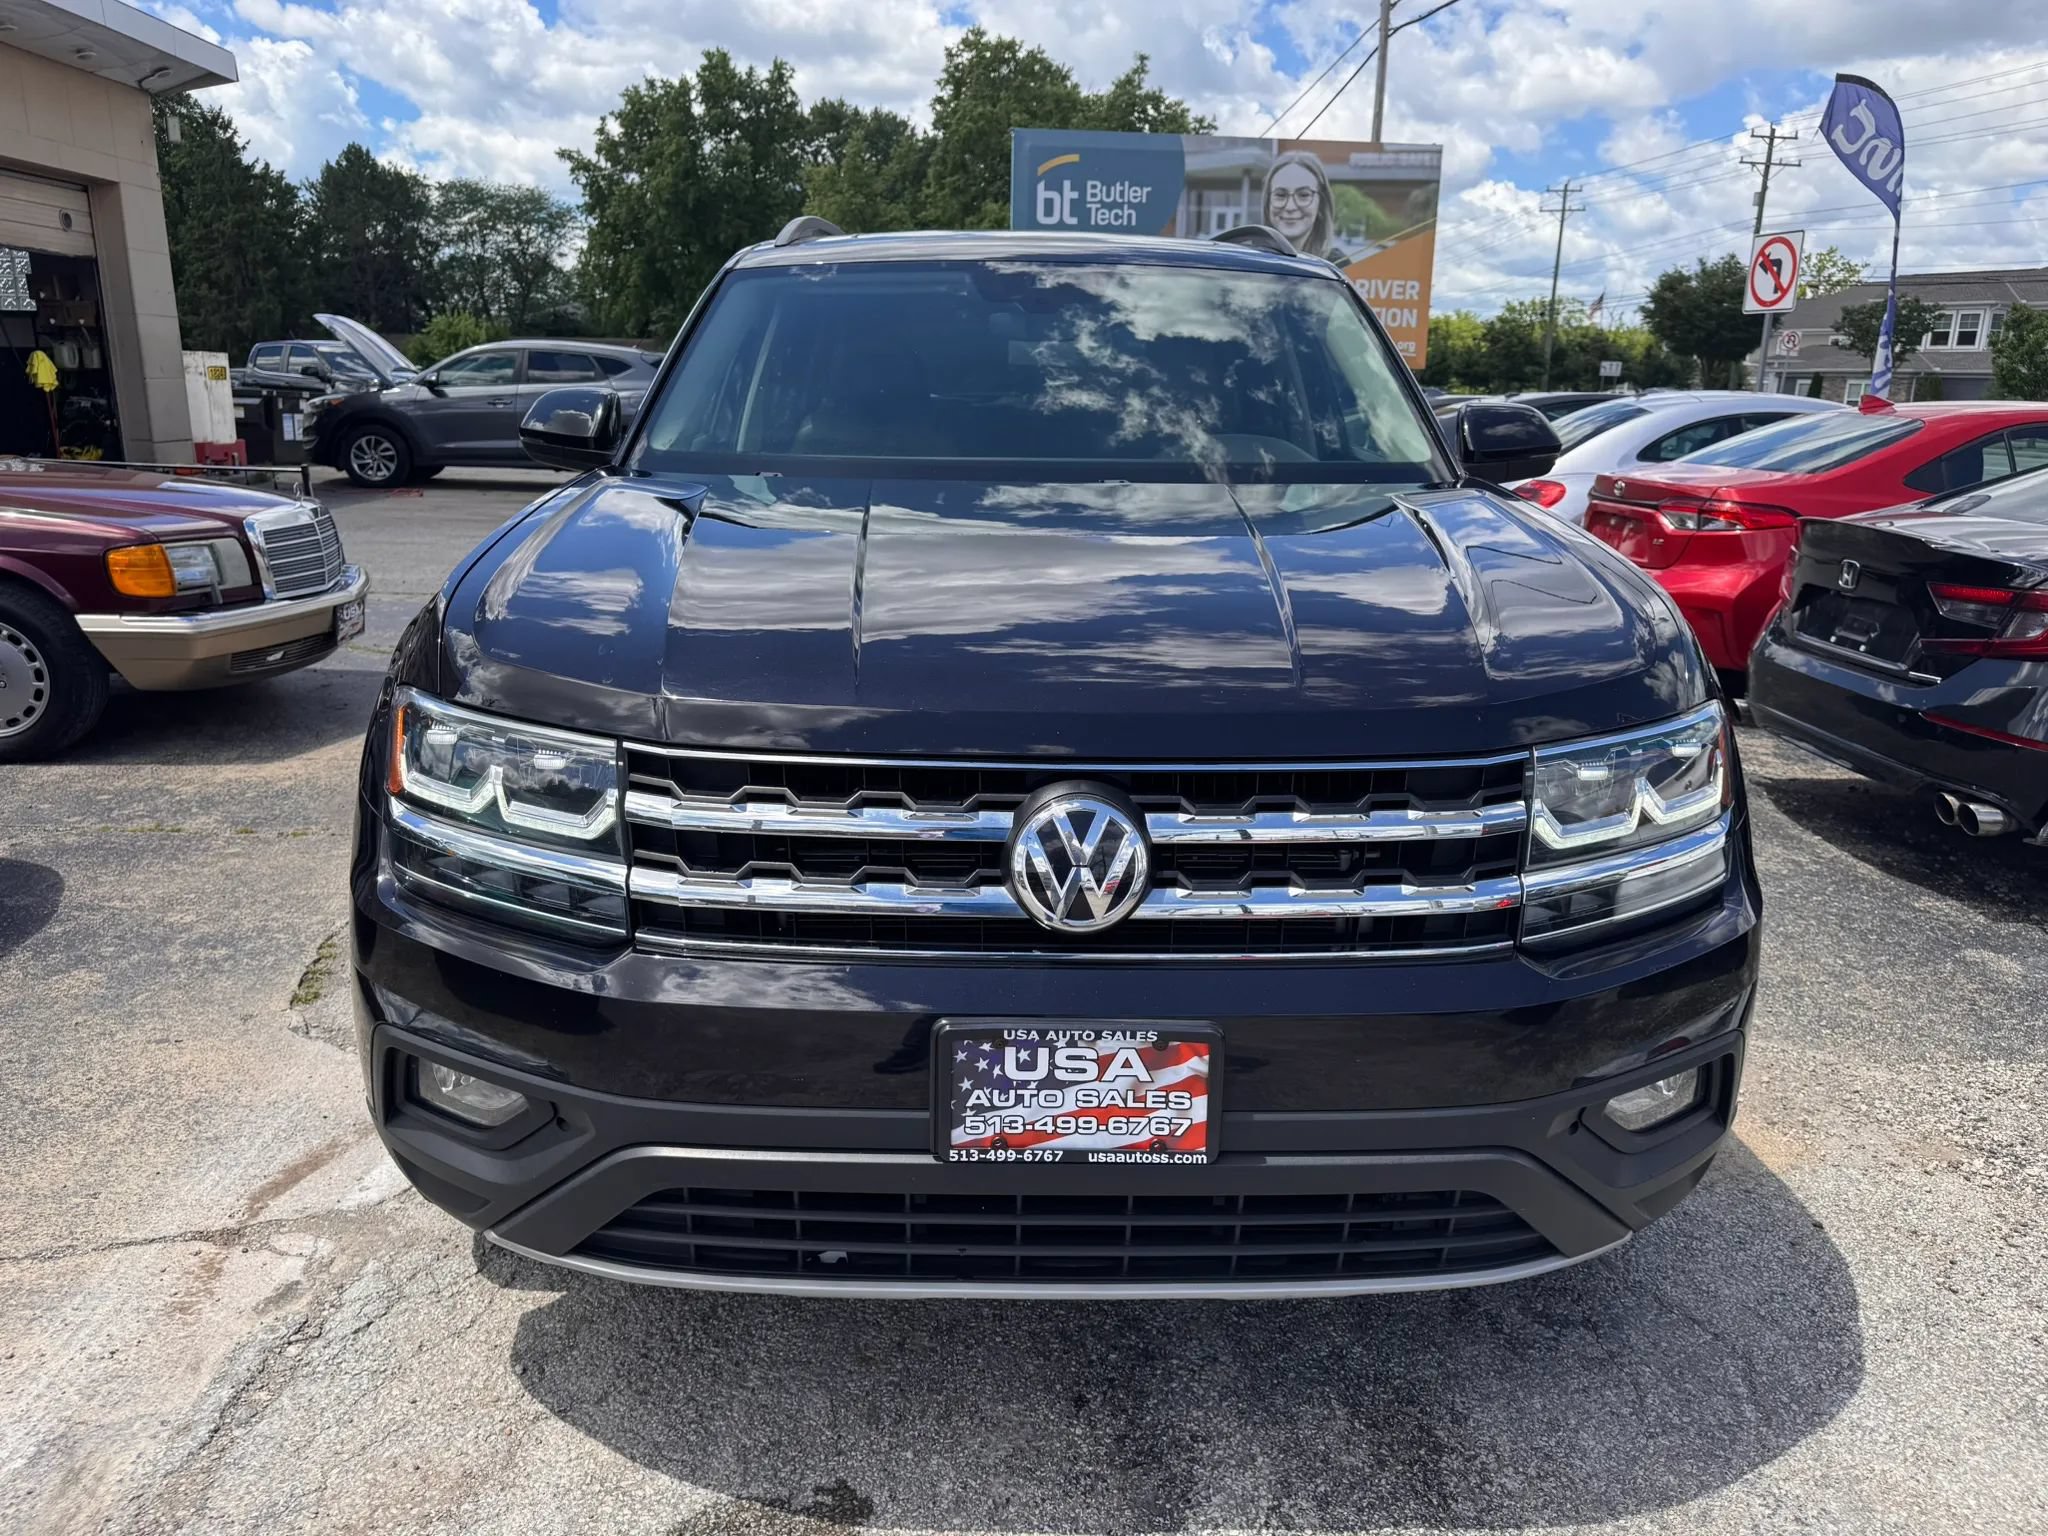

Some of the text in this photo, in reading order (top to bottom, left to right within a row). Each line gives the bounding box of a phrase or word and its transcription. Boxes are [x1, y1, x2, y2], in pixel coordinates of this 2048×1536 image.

[1036, 180, 1079, 225] bt
[1086, 180, 1152, 204] Butler
[1086, 203, 1137, 226] Tech
[1353, 278, 1420, 301] RIVER
[1397, 341, 1416, 352] org
[1003, 1030, 1158, 1042] USA AUTO SALES
[1003, 1046, 1153, 1082] USA
[965, 1089, 1192, 1110] AUTO SALES
[964, 1116, 1193, 1137] 513-499-6767
[949, 1150, 1208, 1164] 513-499-6767 usaautoss.com
